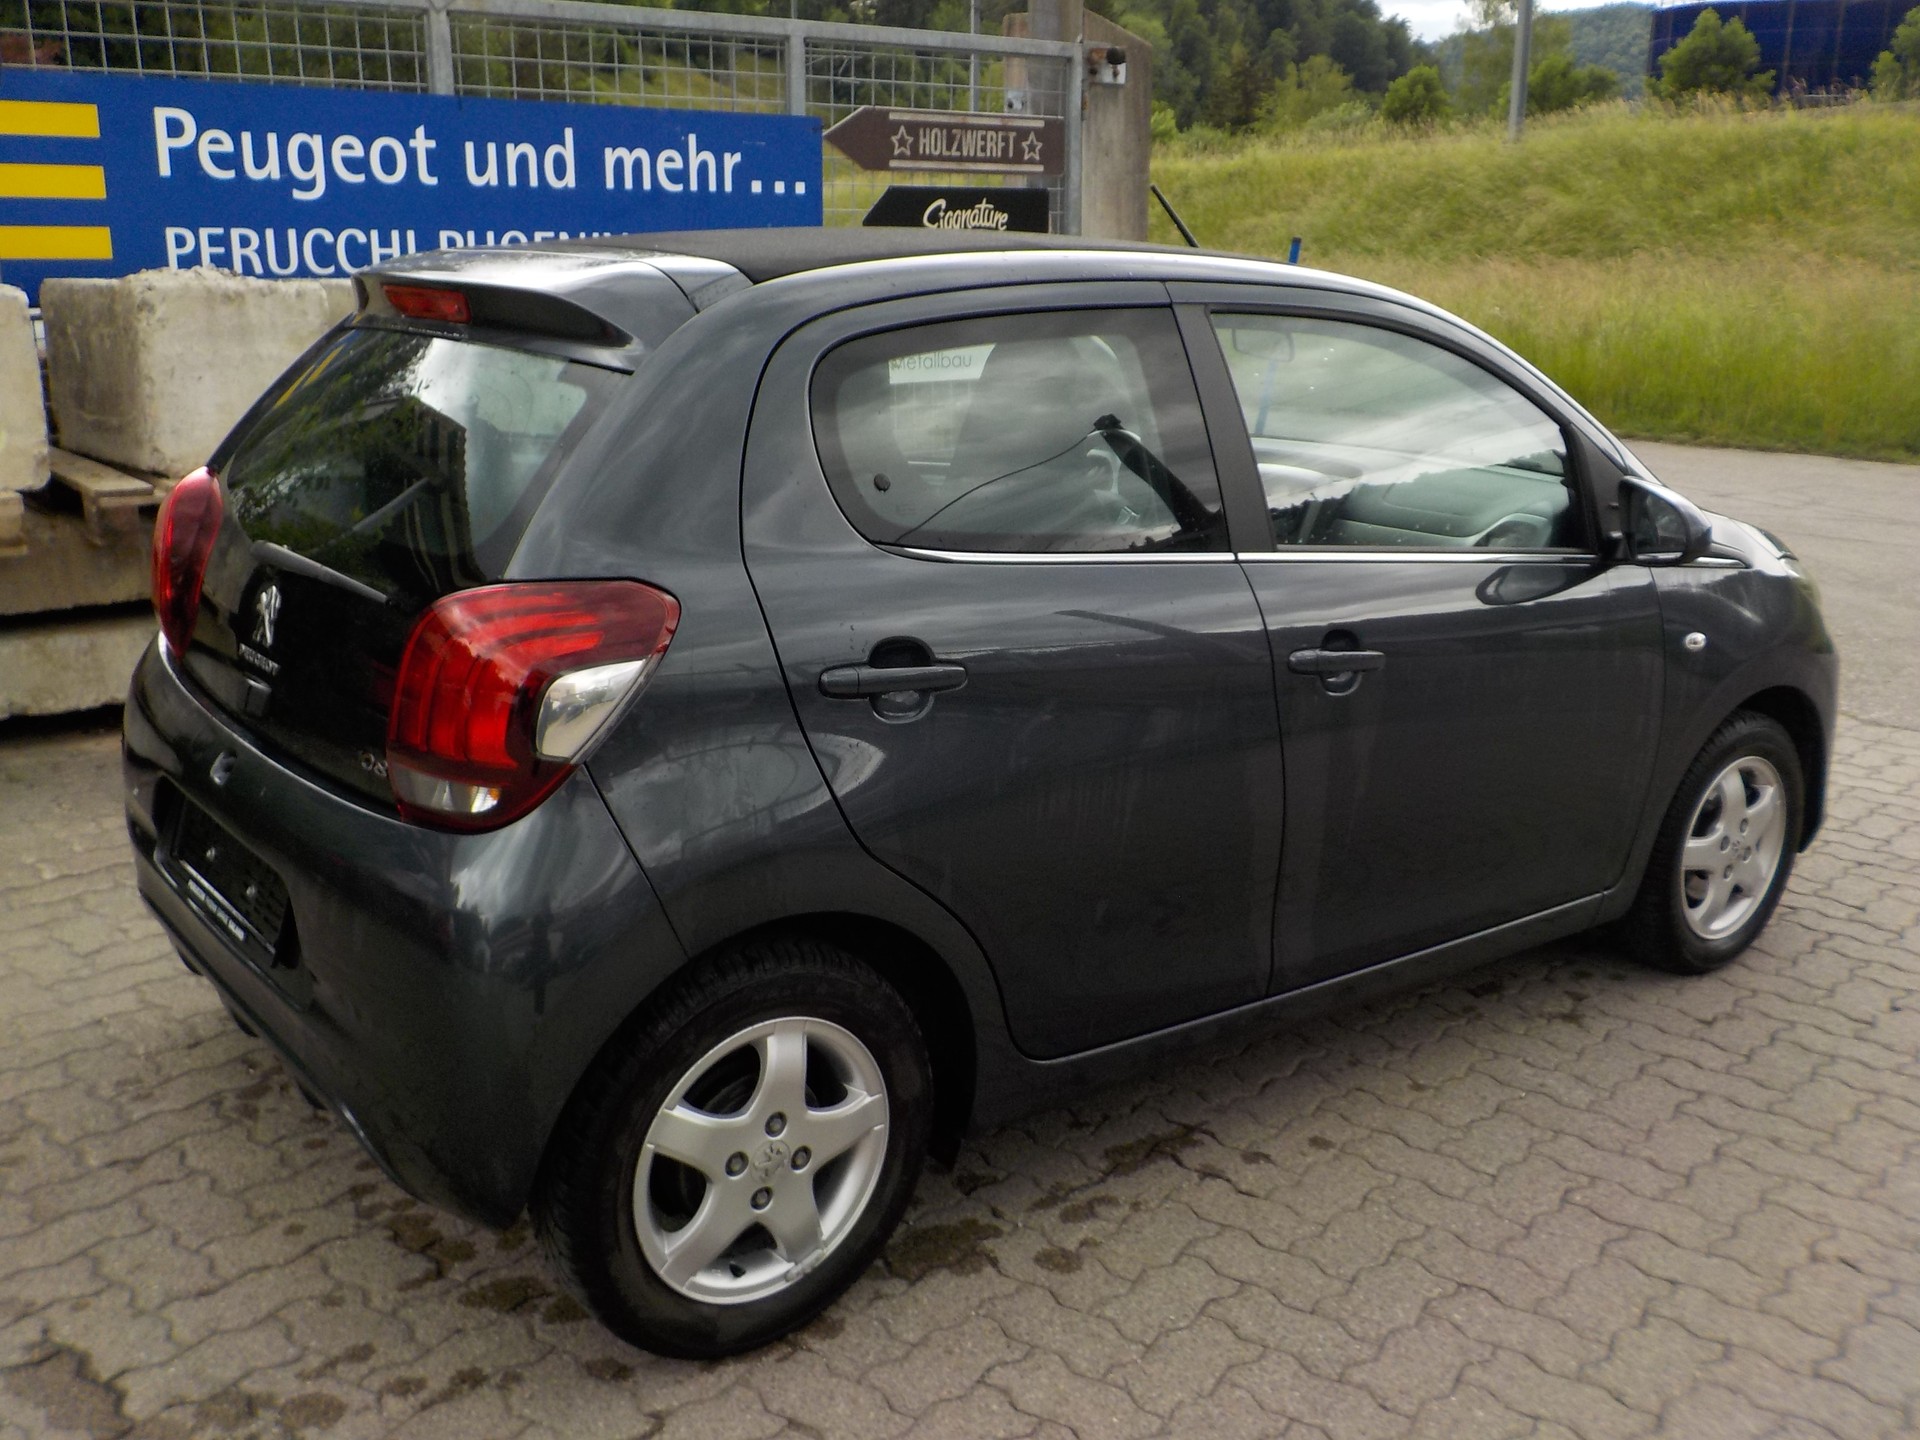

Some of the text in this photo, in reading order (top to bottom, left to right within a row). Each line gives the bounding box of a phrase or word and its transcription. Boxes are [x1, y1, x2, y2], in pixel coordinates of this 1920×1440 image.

[152, 105, 438, 200] Peugeot
[465, 126, 576, 188] und
[919, 127, 1017, 159] HOLZWERFT
